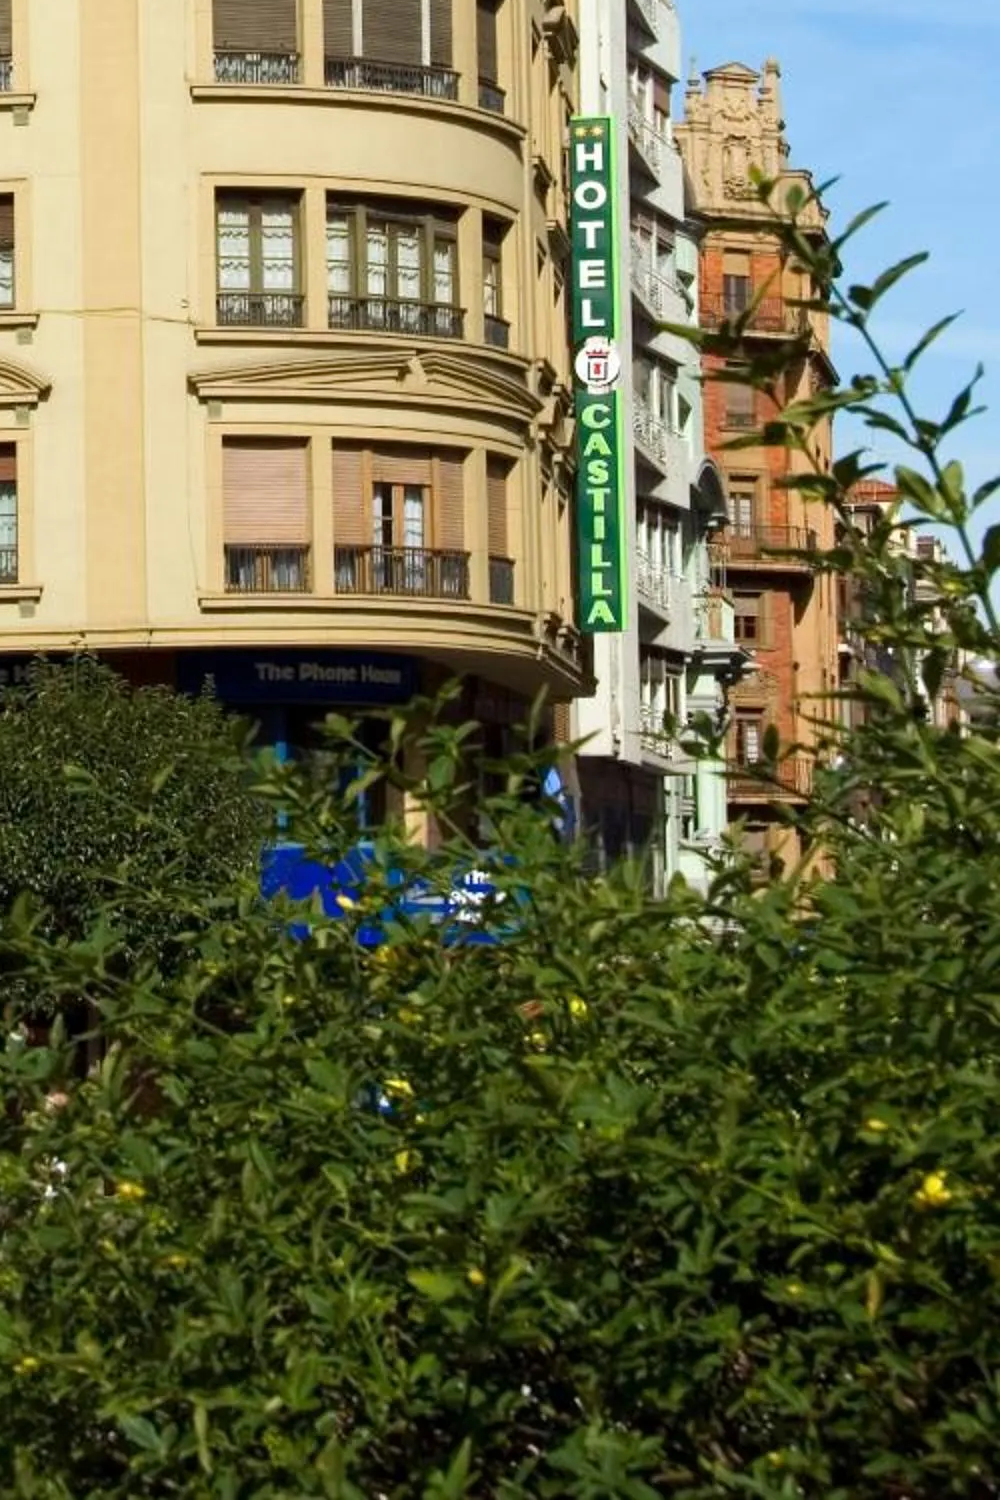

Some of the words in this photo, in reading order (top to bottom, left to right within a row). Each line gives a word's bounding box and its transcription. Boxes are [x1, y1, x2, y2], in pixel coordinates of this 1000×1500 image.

[575, 142, 606, 328] HOTEL
[581, 403, 616, 624] CASTILLA
[254, 662, 295, 681] The
[298, 662, 359, 683] Phone
